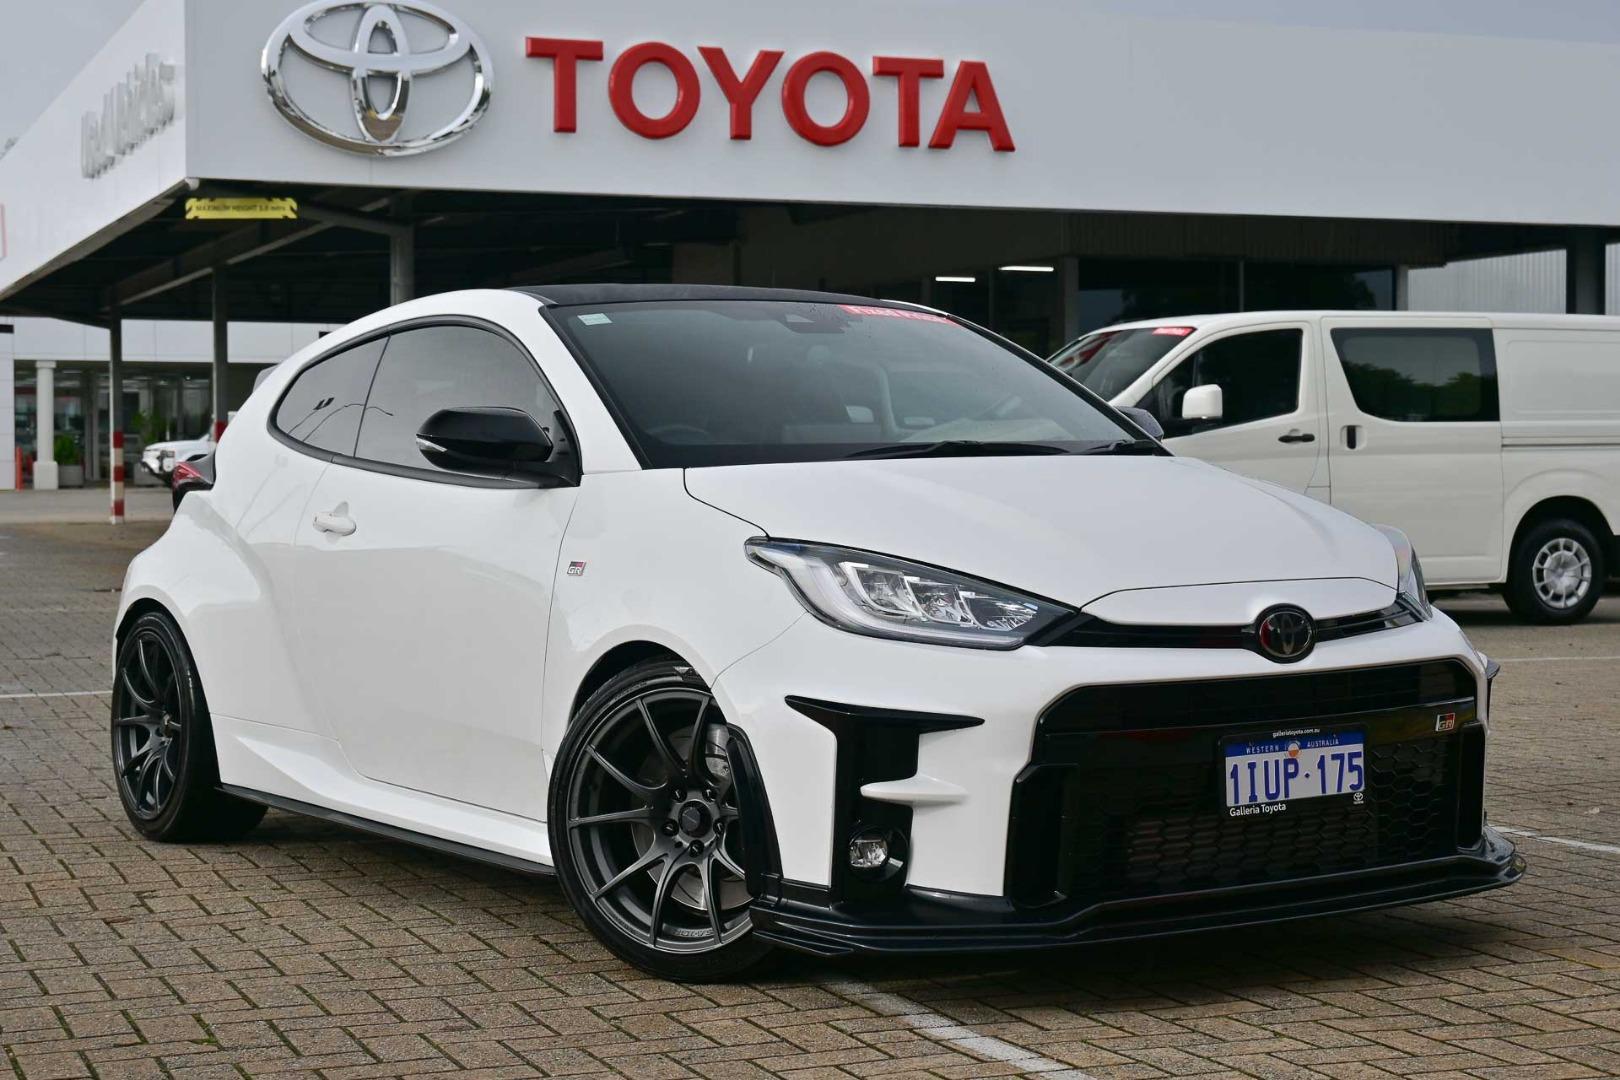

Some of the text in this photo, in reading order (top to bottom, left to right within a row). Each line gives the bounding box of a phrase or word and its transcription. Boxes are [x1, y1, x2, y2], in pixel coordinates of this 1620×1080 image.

[525, 36, 1015, 152] TOYOTA
[1272, 728, 1320, 738] galleriatoyota.com.au
[1246, 738, 1339, 754] WESTERN AUSTRALIA
[1229, 802, 1287, 816] Galleria Toyota
